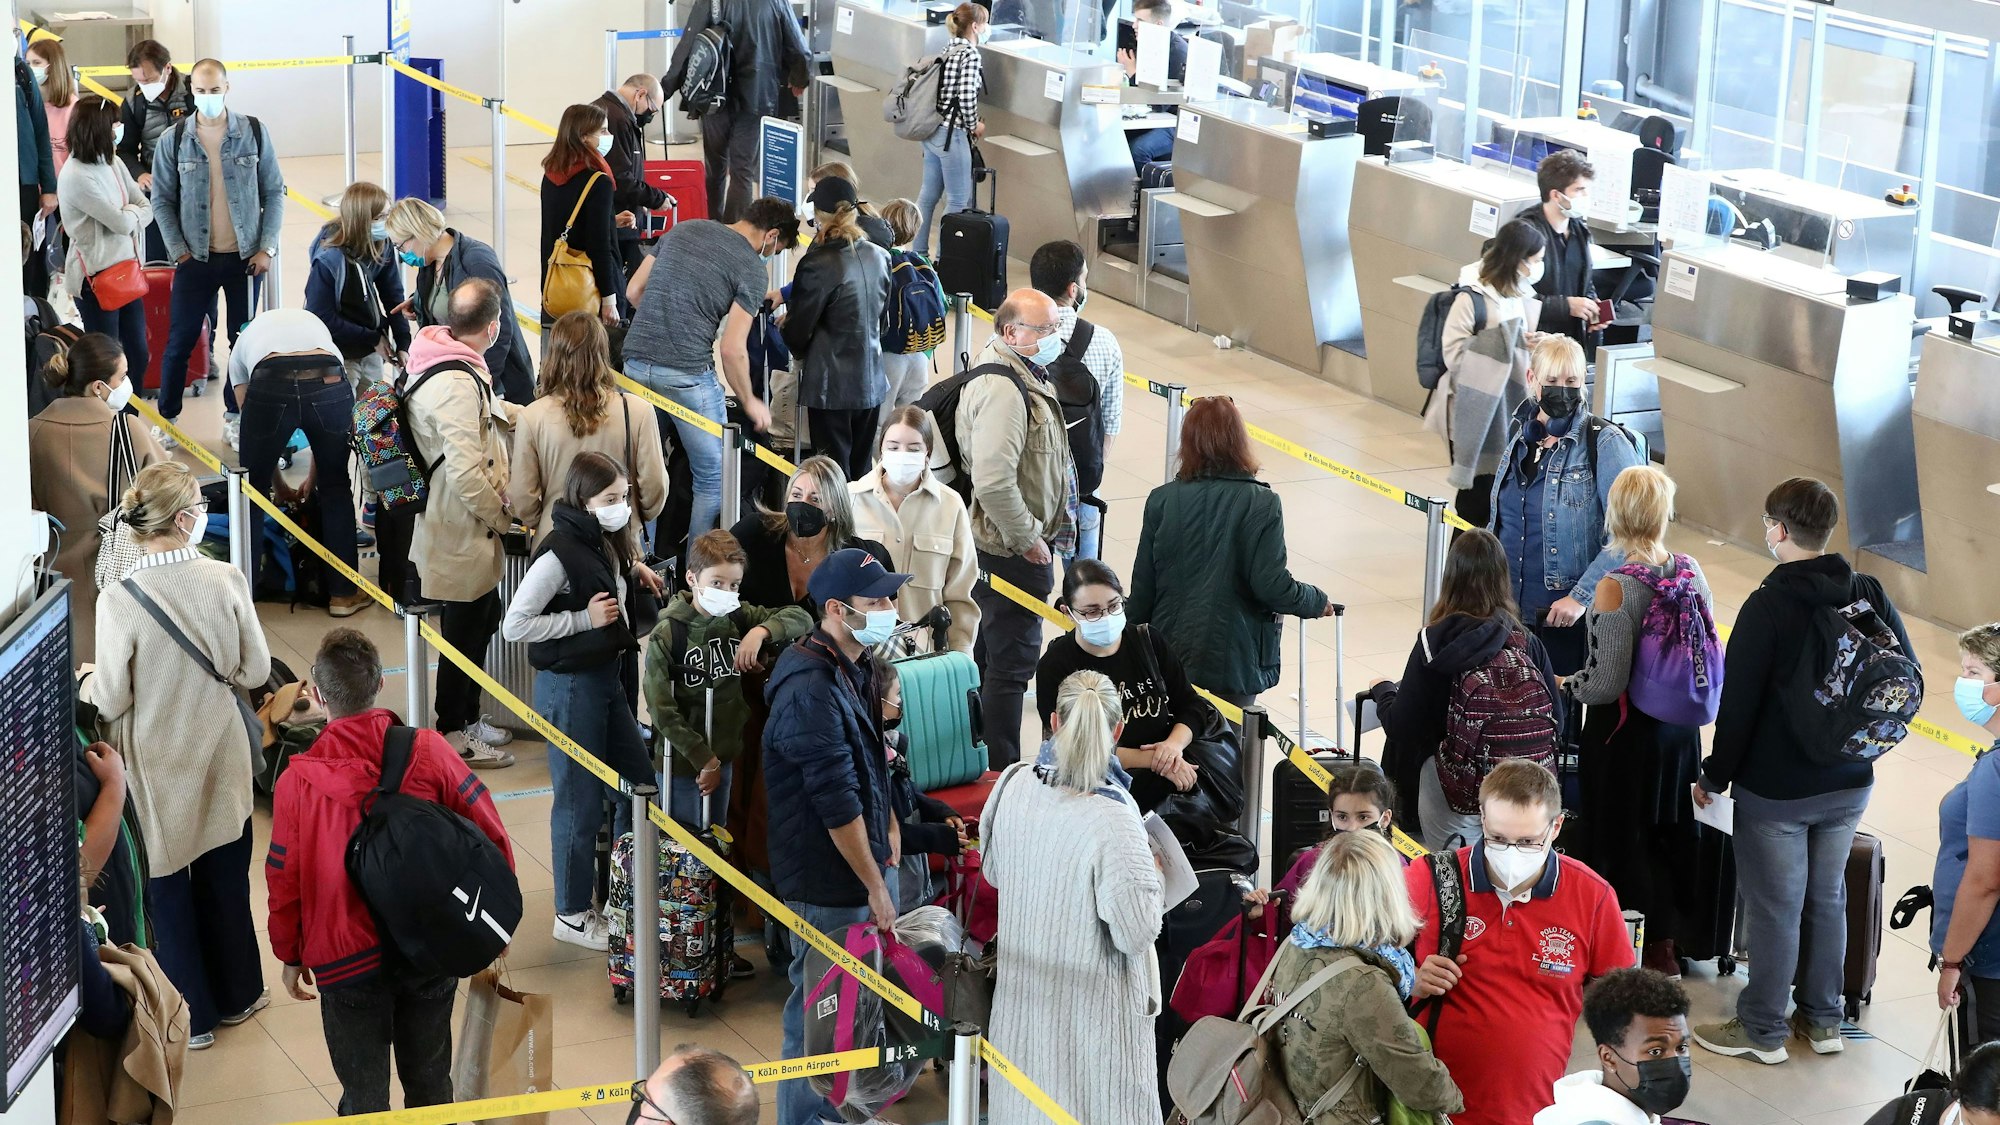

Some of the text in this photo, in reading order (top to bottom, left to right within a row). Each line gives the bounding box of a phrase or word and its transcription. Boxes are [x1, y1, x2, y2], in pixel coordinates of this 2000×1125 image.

[1540, 926, 1577, 942] POLO TEAM
[805, 929, 841, 960] Köln Bonn Airport
[867, 974, 904, 1005] Köln Bonn Airport
[758, 1058, 840, 1078] Köln Bonn Airport
[609, 1086, 630, 1098] Köln
